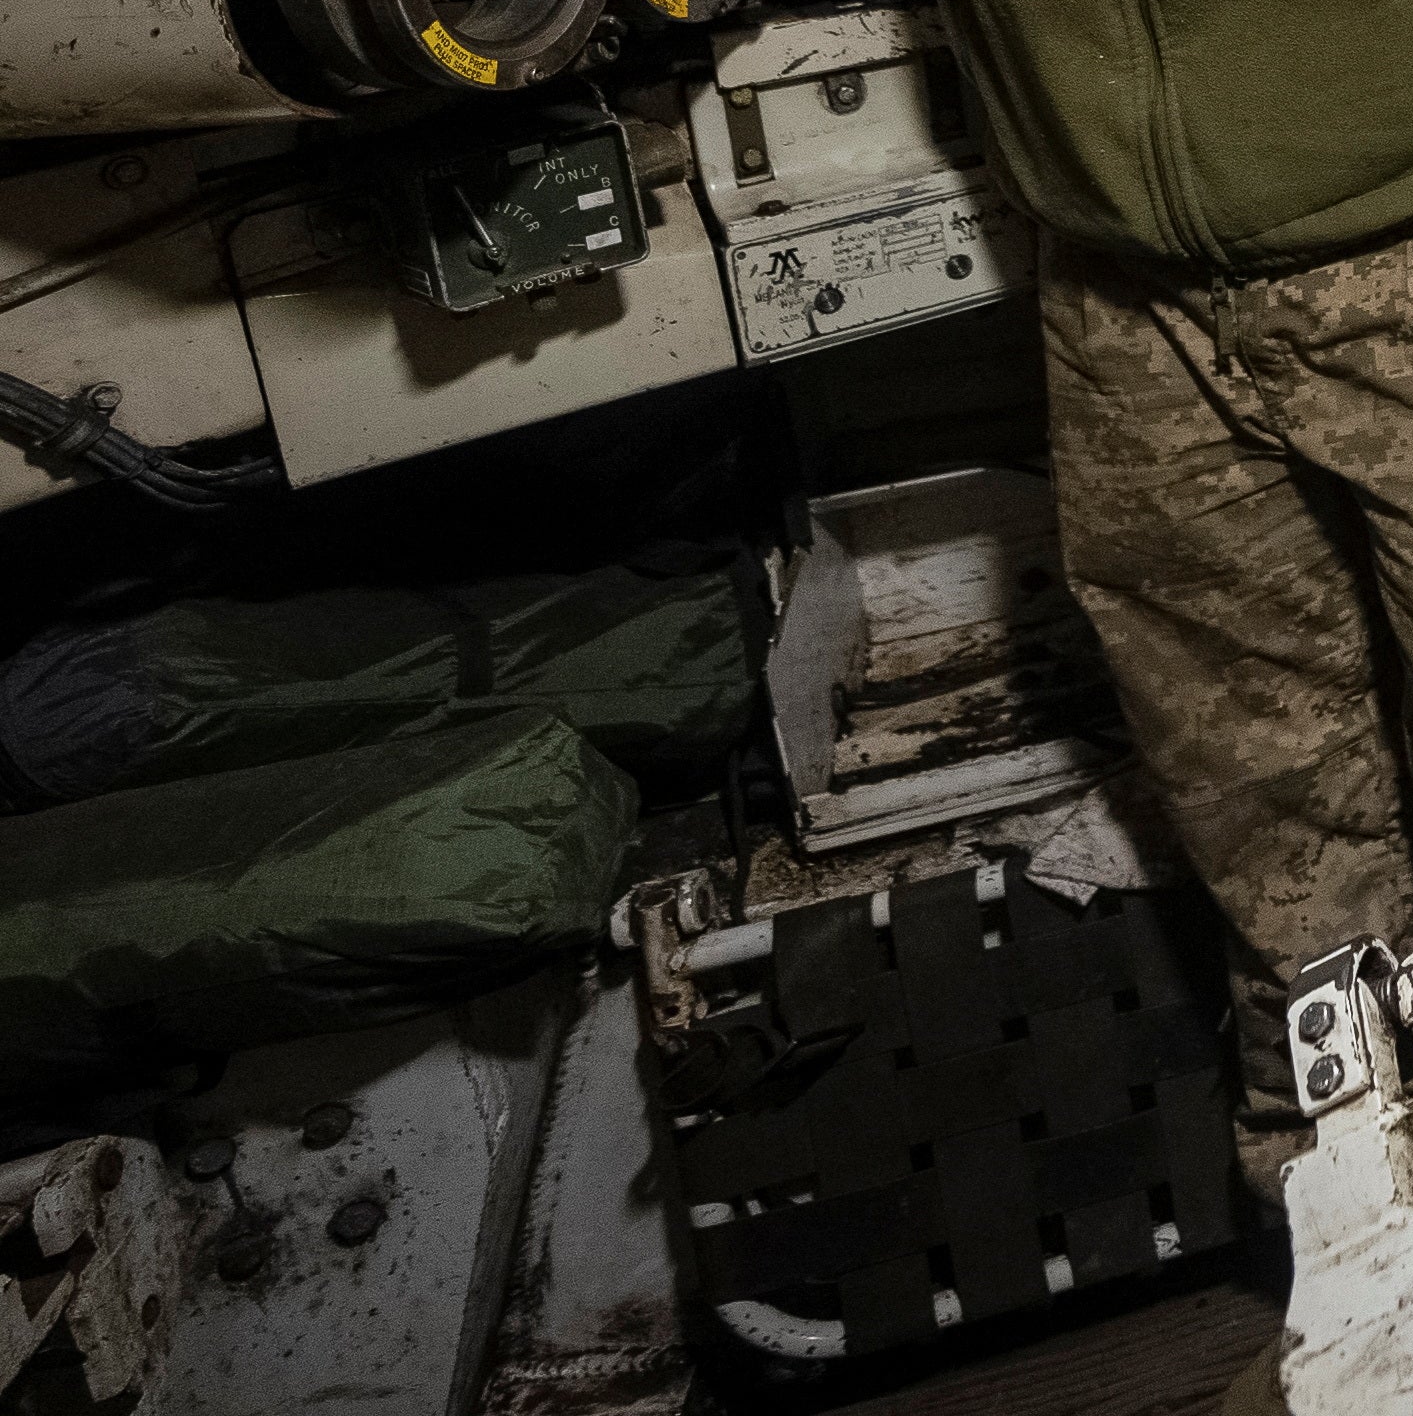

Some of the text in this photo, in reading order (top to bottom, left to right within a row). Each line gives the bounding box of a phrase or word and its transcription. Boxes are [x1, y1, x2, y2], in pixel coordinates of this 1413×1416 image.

[435, 29, 451, 48] AND
[539, 156, 566, 174] INT
[555, 163, 599, 184] ONLY
[601, 176, 611, 188] B
[609, 215, 620, 227] C
[511, 267, 586, 294] VOLUME
